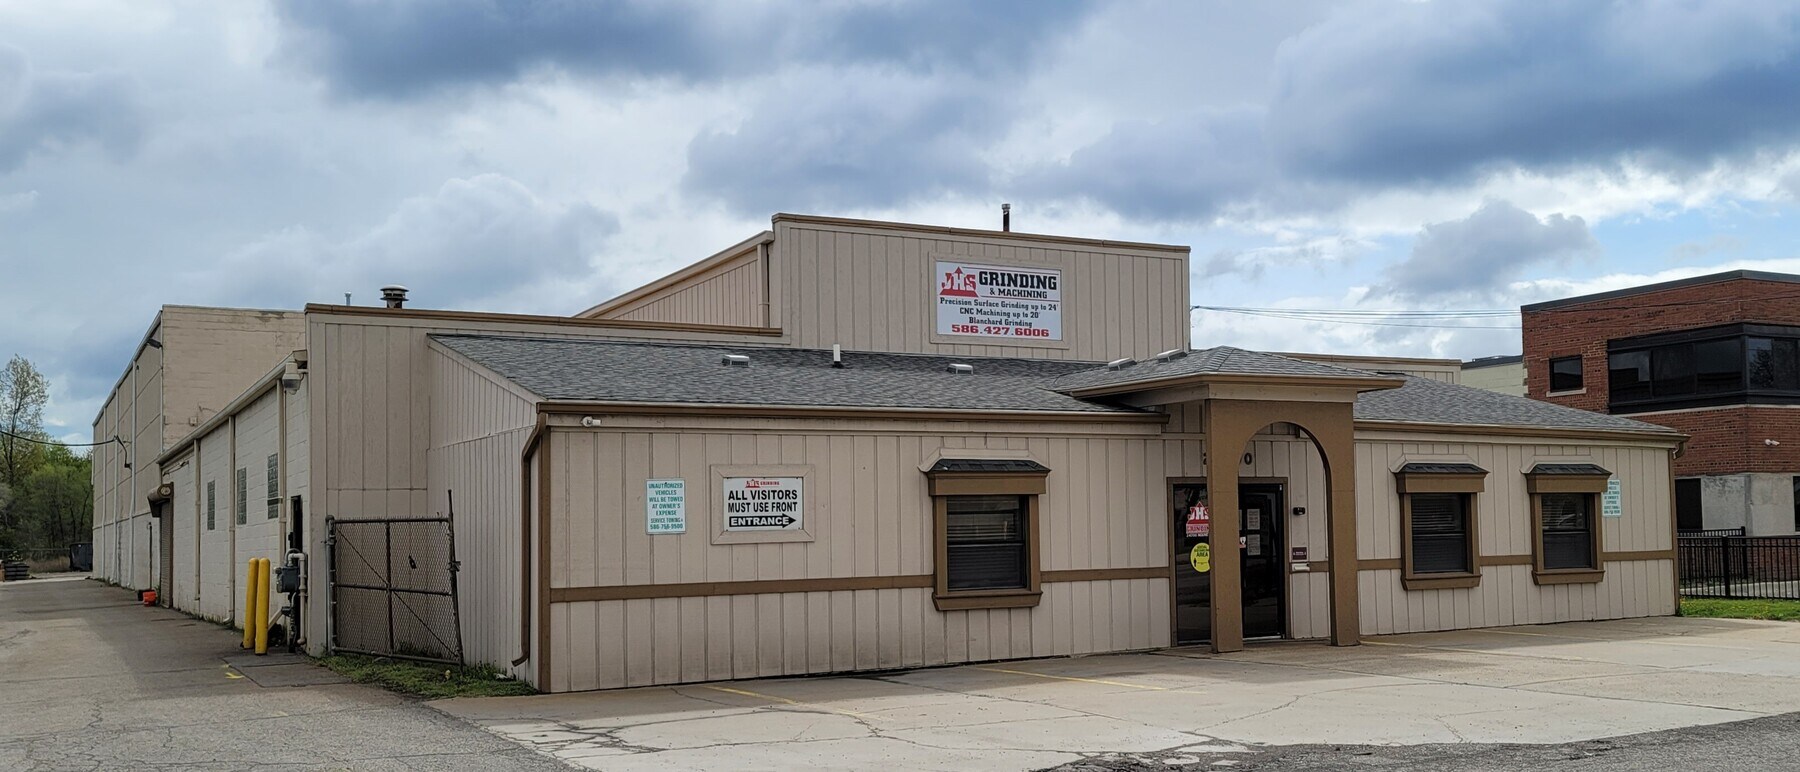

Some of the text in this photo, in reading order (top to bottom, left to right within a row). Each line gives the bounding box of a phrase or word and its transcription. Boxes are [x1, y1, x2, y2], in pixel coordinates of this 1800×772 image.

[978, 271, 1057, 290] GRINDING
[989, 287, 1048, 299] & MACHINING
[940, 297, 972, 306] Precision
[974, 299, 999, 308] Surface
[1001, 301, 1029, 311] Grinding
[1031, 303, 1039, 311] up
[959, 307, 974, 315] CNC
[976, 308, 1011, 318] Machining
[1012, 311, 1020, 319] up
[969, 317, 1032, 328] Blanchard Grinding
[952, 324, 1049, 337] 586.427.6006
[728, 489, 798, 500] ALL VISITORS
[728, 501, 798, 513] MUST USE FRONT
[730, 516, 790, 526] ENTRANCE
